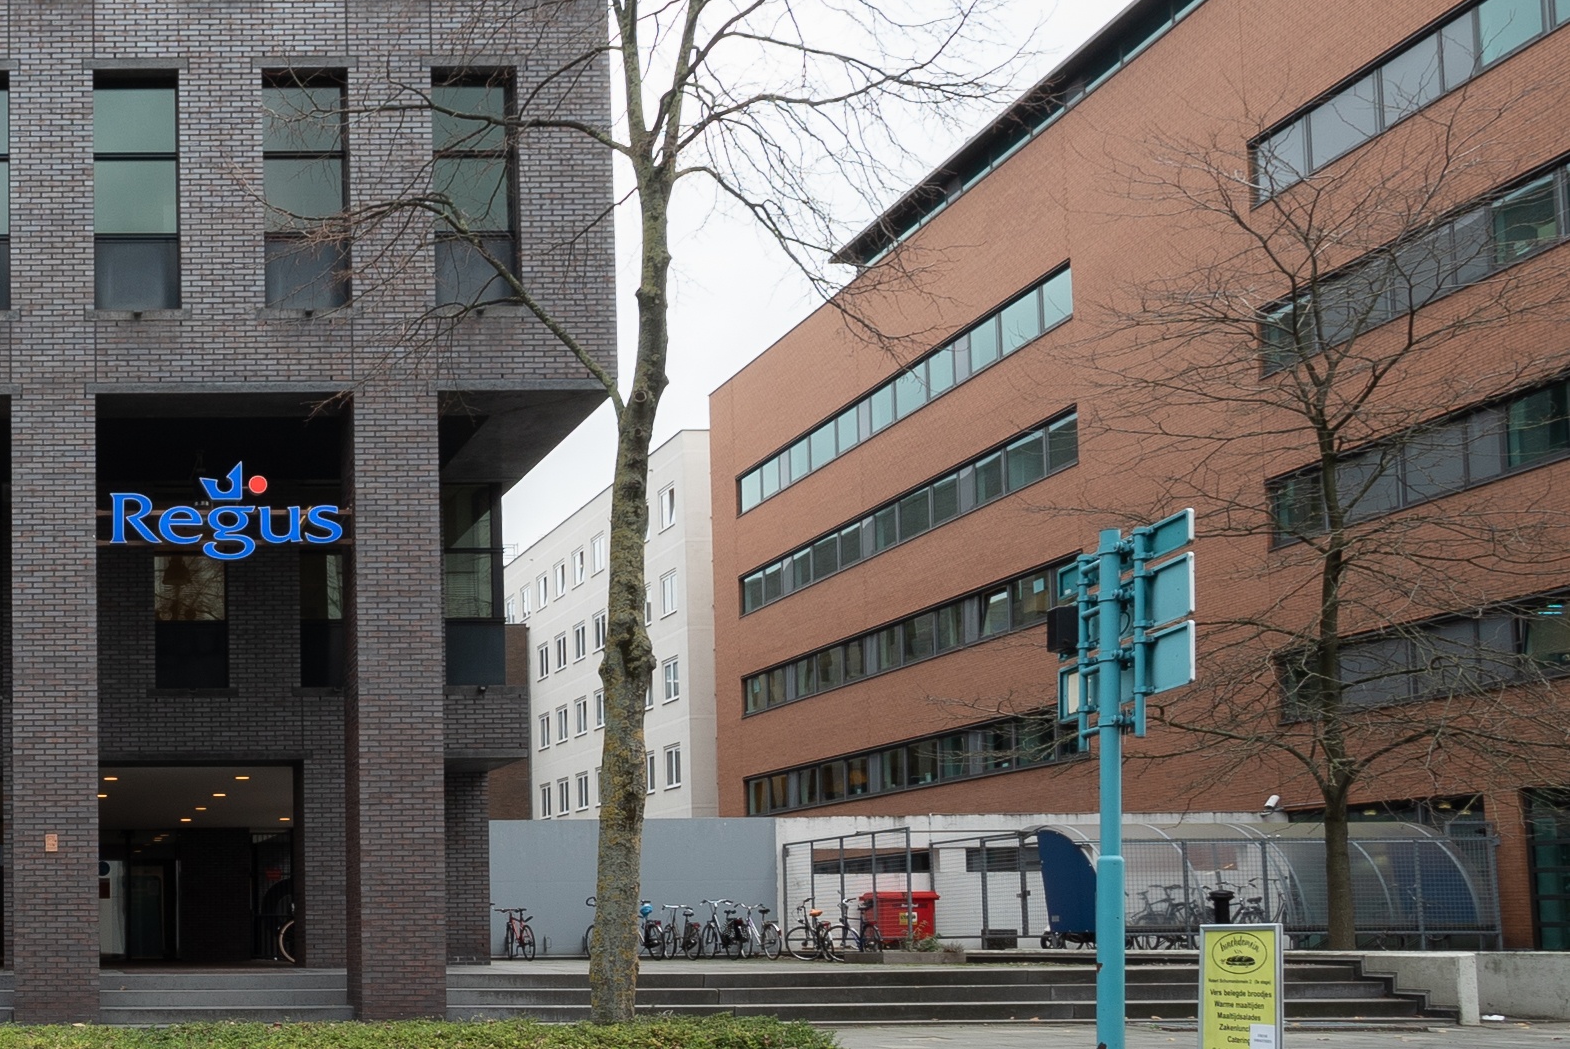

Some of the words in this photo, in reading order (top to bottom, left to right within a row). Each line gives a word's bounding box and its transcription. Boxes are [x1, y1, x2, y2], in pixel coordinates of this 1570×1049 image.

[109, 492, 343, 560] Regus
[1223, 989, 1246, 998] belegde
[1247, 990, 1272, 999] broodjes
[1214, 1000, 1234, 1008] Warme
[1235, 1002, 1265, 1011] maaltijden
